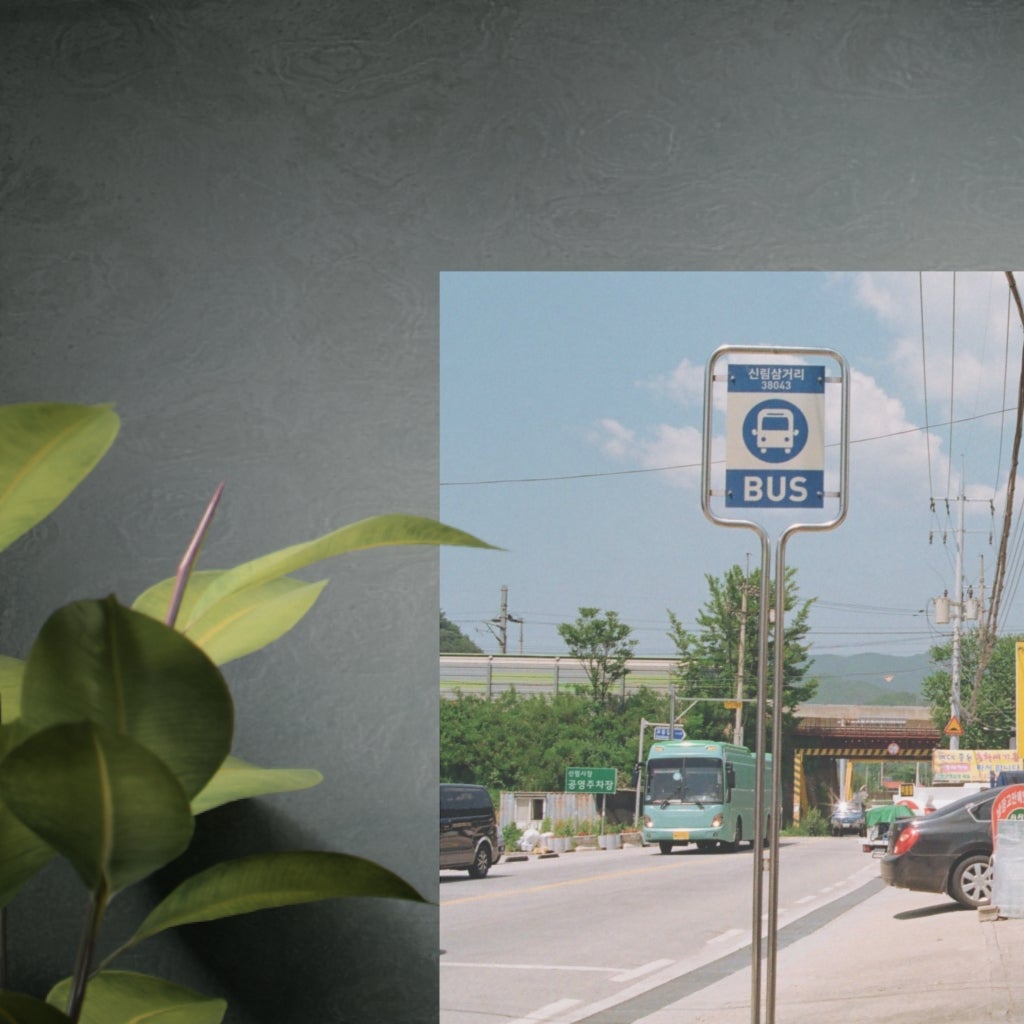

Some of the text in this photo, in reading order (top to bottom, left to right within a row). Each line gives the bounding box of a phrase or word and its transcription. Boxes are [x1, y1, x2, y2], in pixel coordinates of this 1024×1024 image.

[748, 367, 805, 381] 신림삼거리
[761, 381, 792, 391] 38043
[743, 475, 808, 502] BUS
[567, 779, 614, 791] 공영주차장
